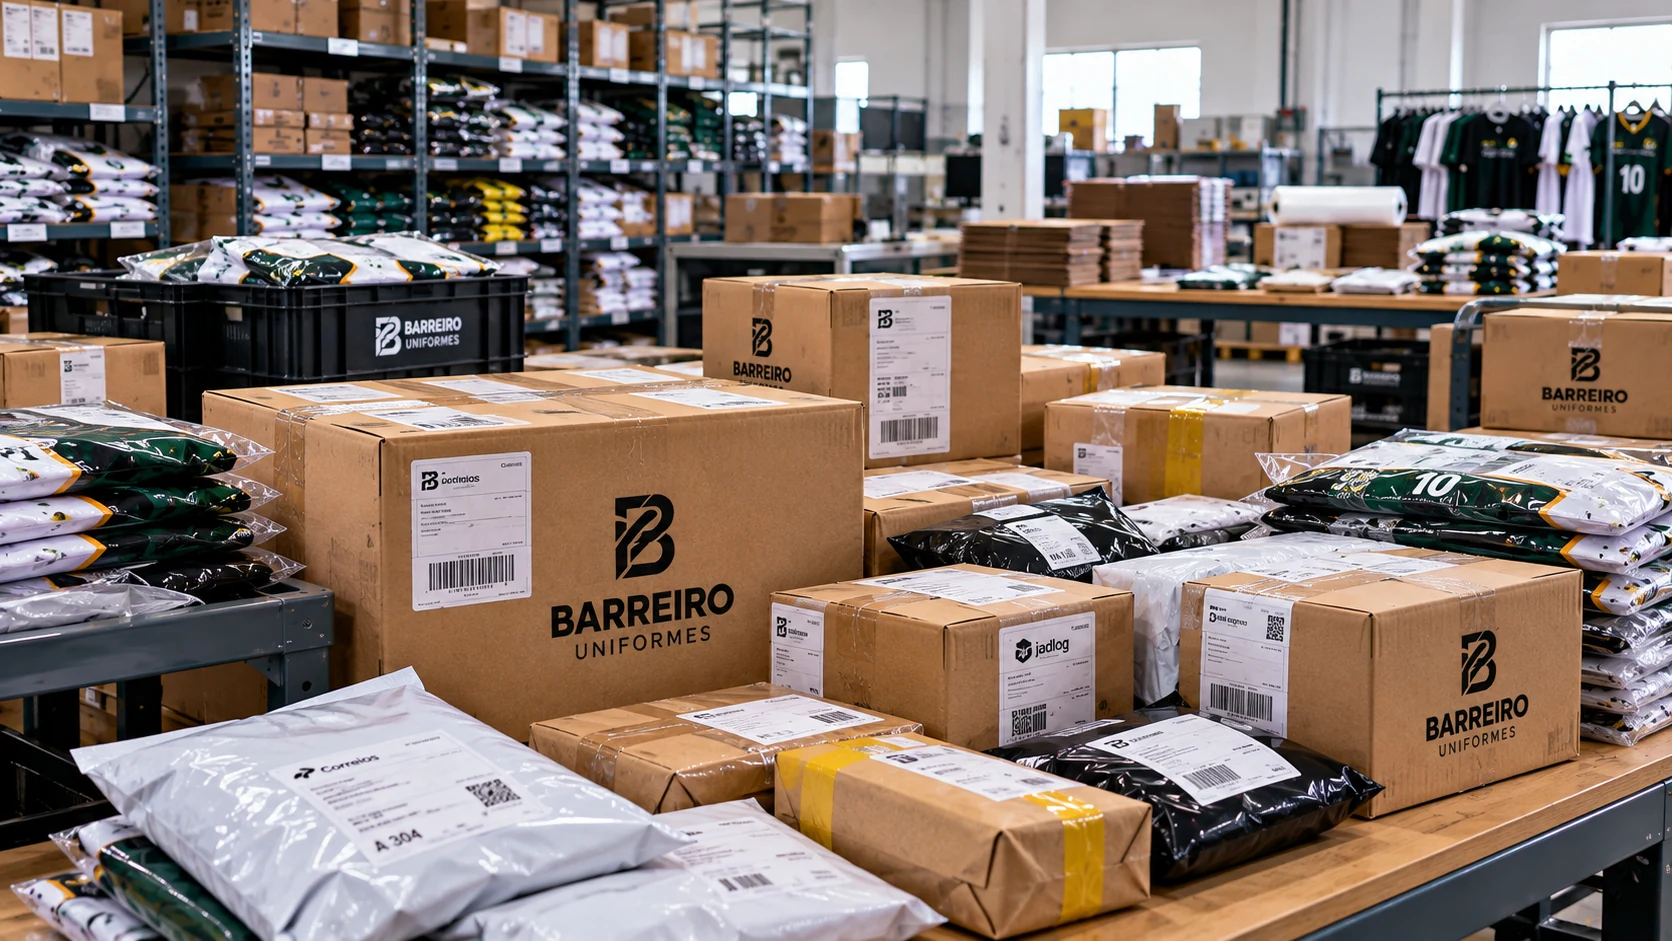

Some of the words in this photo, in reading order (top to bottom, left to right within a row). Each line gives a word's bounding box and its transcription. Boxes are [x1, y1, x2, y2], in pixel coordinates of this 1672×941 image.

[1619, 164, 1646, 195] 10
[404, 316, 462, 335] BARREIRO
[405, 334, 460, 349] UNIFORMES
[733, 360, 792, 384] BARREIRO
[1541, 386, 1628, 404] BARREIRO
[1551, 403, 1617, 414] UNIFORMES
[1412, 472, 1462, 497] 10
[551, 583, 735, 639] BARREIRO
[575, 625, 711, 660] UNIFORMES
[1035, 638, 1070, 658] jadlog
[1426, 694, 1529, 742] BARREIRO
[1439, 725, 1517, 758] UNIFORMES
[320, 755, 380, 773] Correios
[375, 840, 391, 852] A
[388, 829, 424, 847] 304
